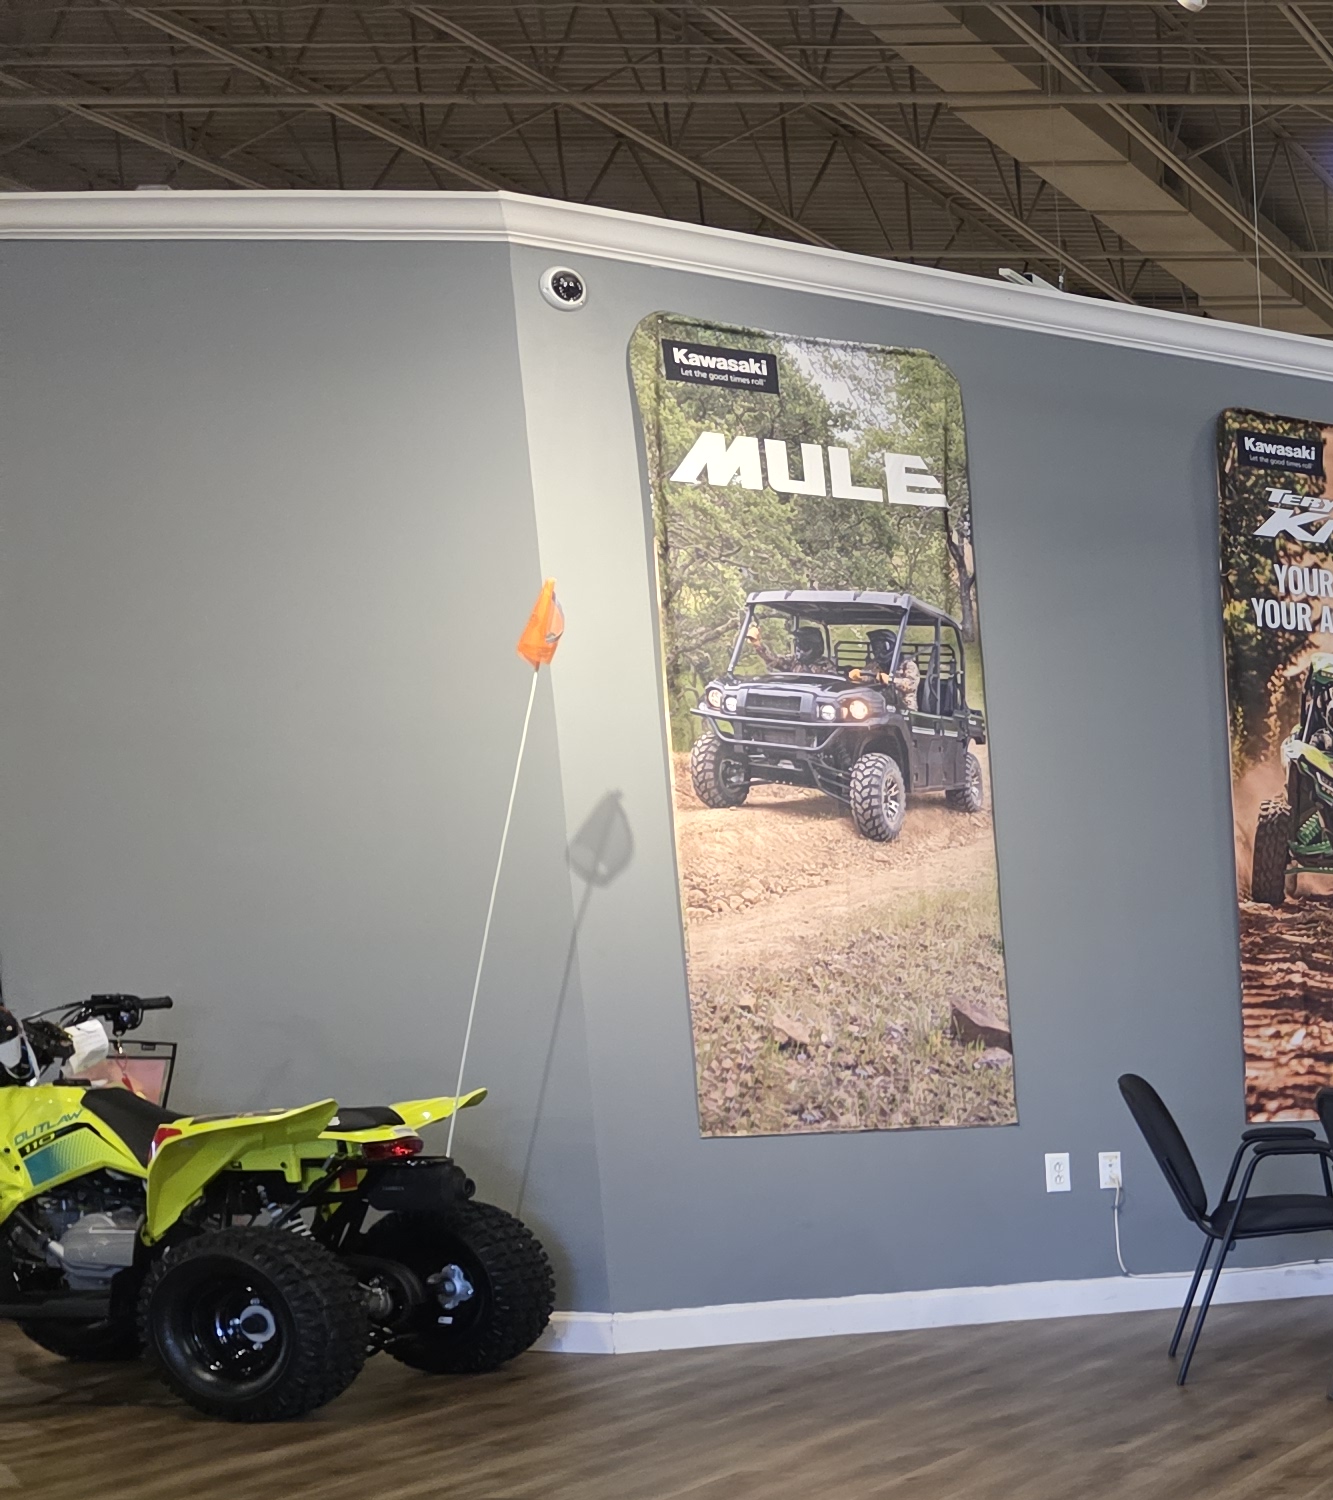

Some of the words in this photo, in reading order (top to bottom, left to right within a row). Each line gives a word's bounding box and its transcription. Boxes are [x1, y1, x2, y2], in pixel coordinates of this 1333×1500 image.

[672, 346, 768, 376] Kawasaki
[680, 367, 693, 377] Let
[694, 369, 708, 379] the
[709, 371, 729, 382] good
[730, 374, 751, 385] times
[751, 376, 764, 387] roll
[1244, 436, 1316, 461] Kawasaki
[669, 431, 949, 509] MULE
[1251, 597, 1313, 632] YOUR
[14, 1108, 83, 1147] OUTLAW
[25, 1132, 56, 1154] 110
